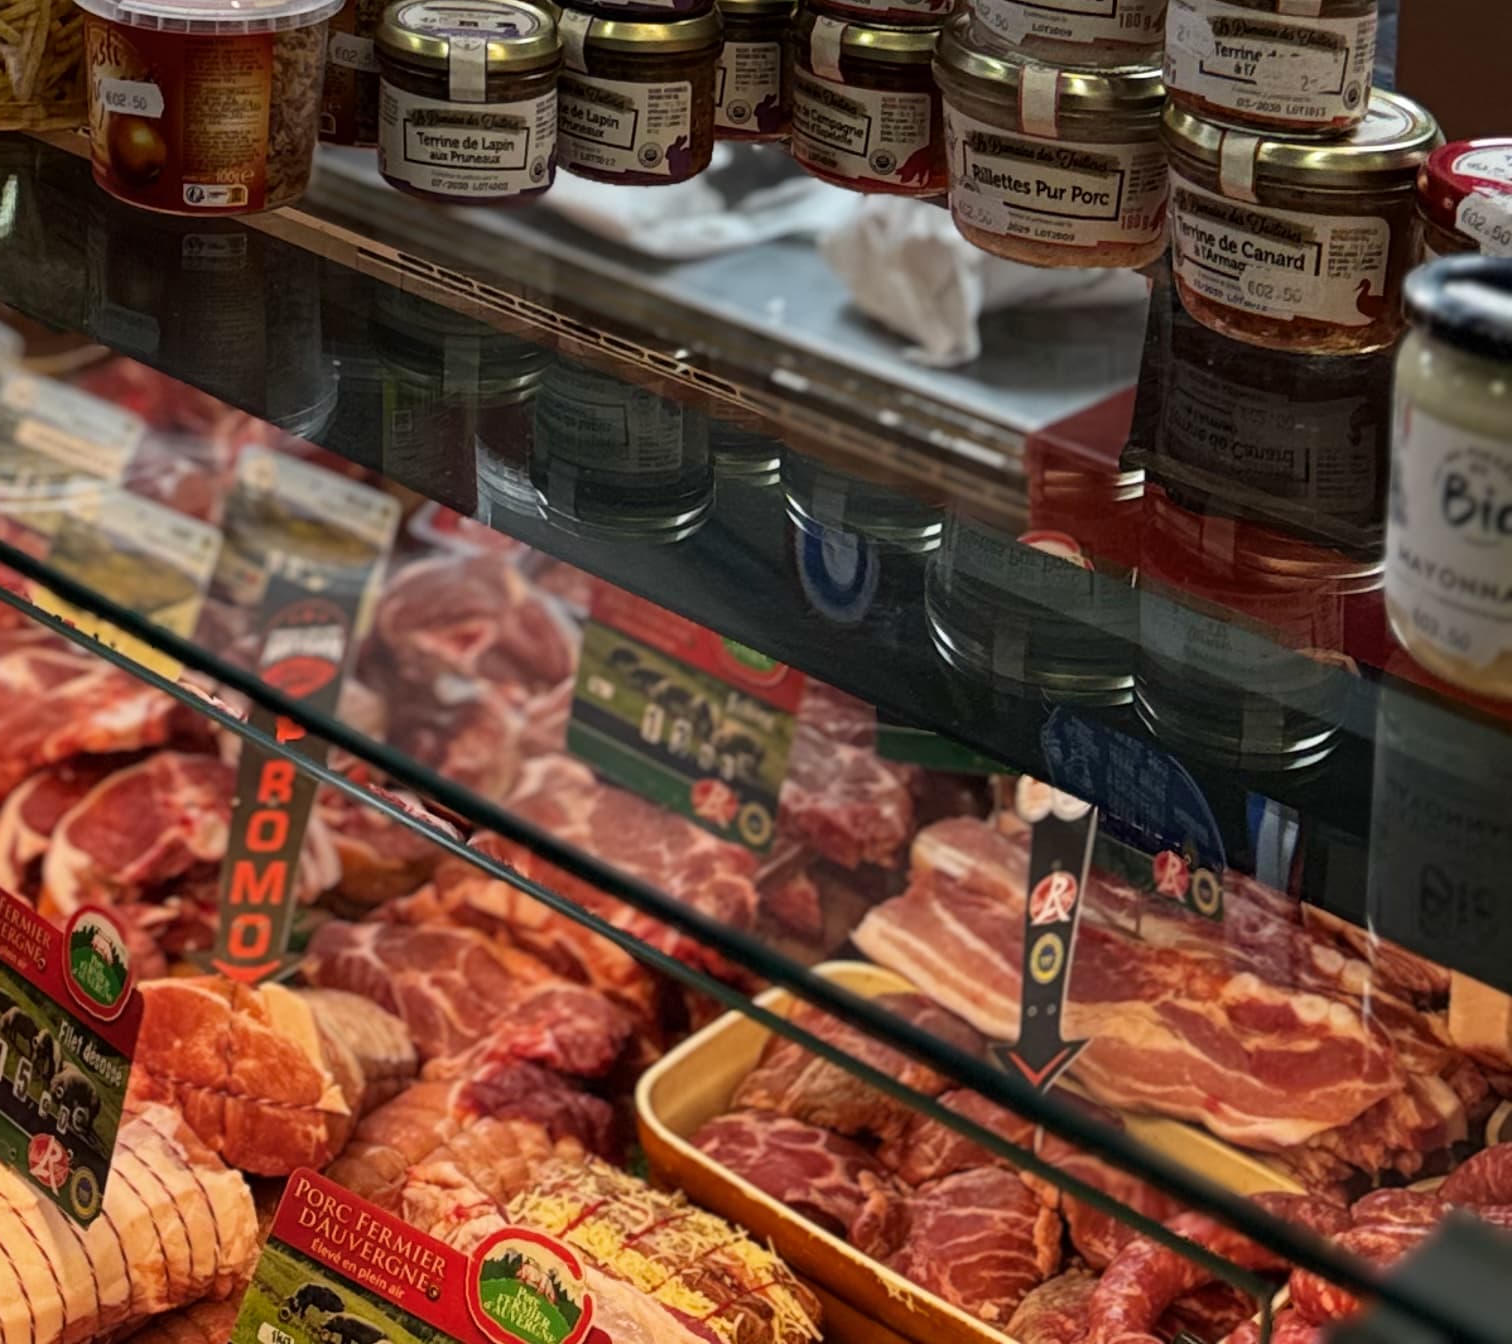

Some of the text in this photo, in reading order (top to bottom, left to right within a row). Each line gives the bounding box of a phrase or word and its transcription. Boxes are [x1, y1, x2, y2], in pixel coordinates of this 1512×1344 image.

[1214, 40, 1264, 63] Terrine
[104, 89, 149, 112] €02.50
[585, 107, 620, 130] Lapin
[416, 131, 516, 154] Terrine de Lapin
[429, 150, 502, 165] aux Pruneaux
[971, 162, 1111, 207] Rillettes Pur Porc
[1460, 207, 1511, 247] €02.50
[1177, 214, 1216, 245] Terrine
[1218, 234, 1238, 254] de
[1240, 240, 1307, 272] Canard
[1246, 280, 1304, 305] €02.50
[57, 1018, 84, 1056] Filet
[294, 1176, 446, 1278] PORC FERMIER
[310, 1237, 406, 1300] Élevé en plein air
